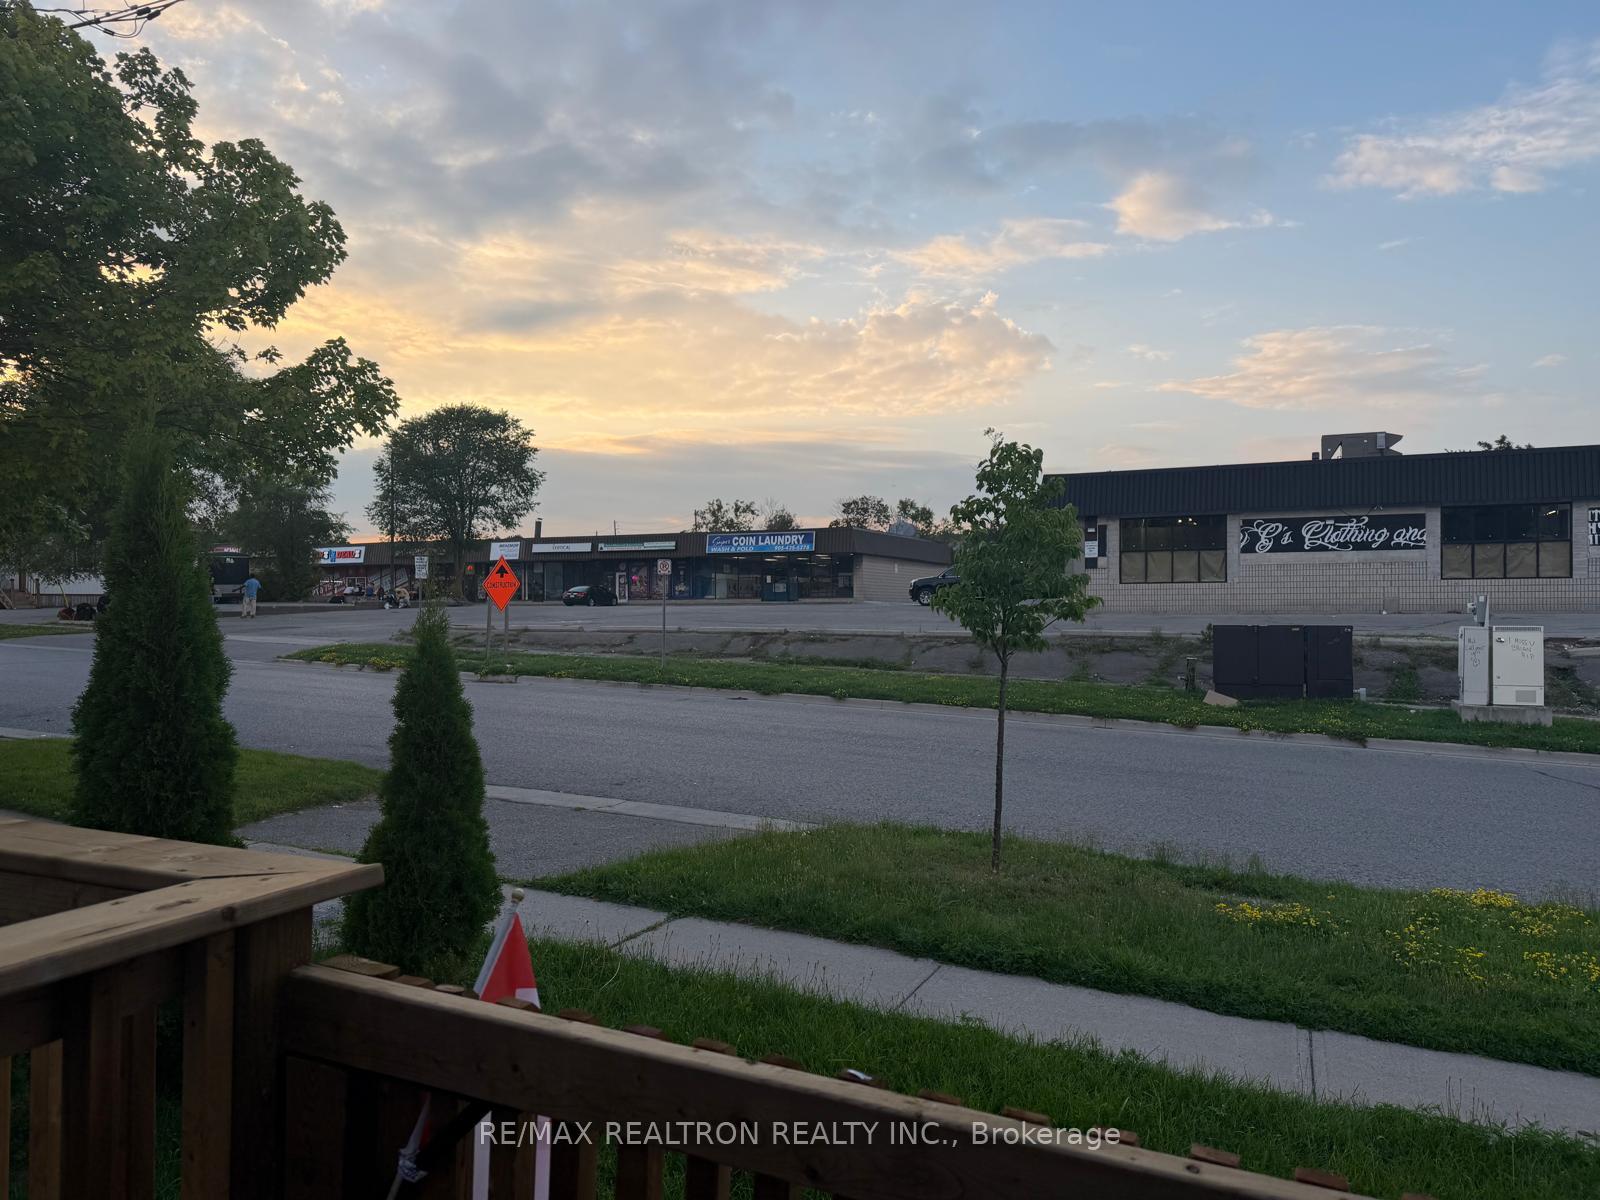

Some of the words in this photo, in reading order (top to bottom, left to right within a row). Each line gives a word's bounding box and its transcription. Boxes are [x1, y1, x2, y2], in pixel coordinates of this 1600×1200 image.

[732, 536, 756, 546] COIN
[758, 534, 805, 545] LAUNDRY
[1301, 516, 1390, 551] Clothing
